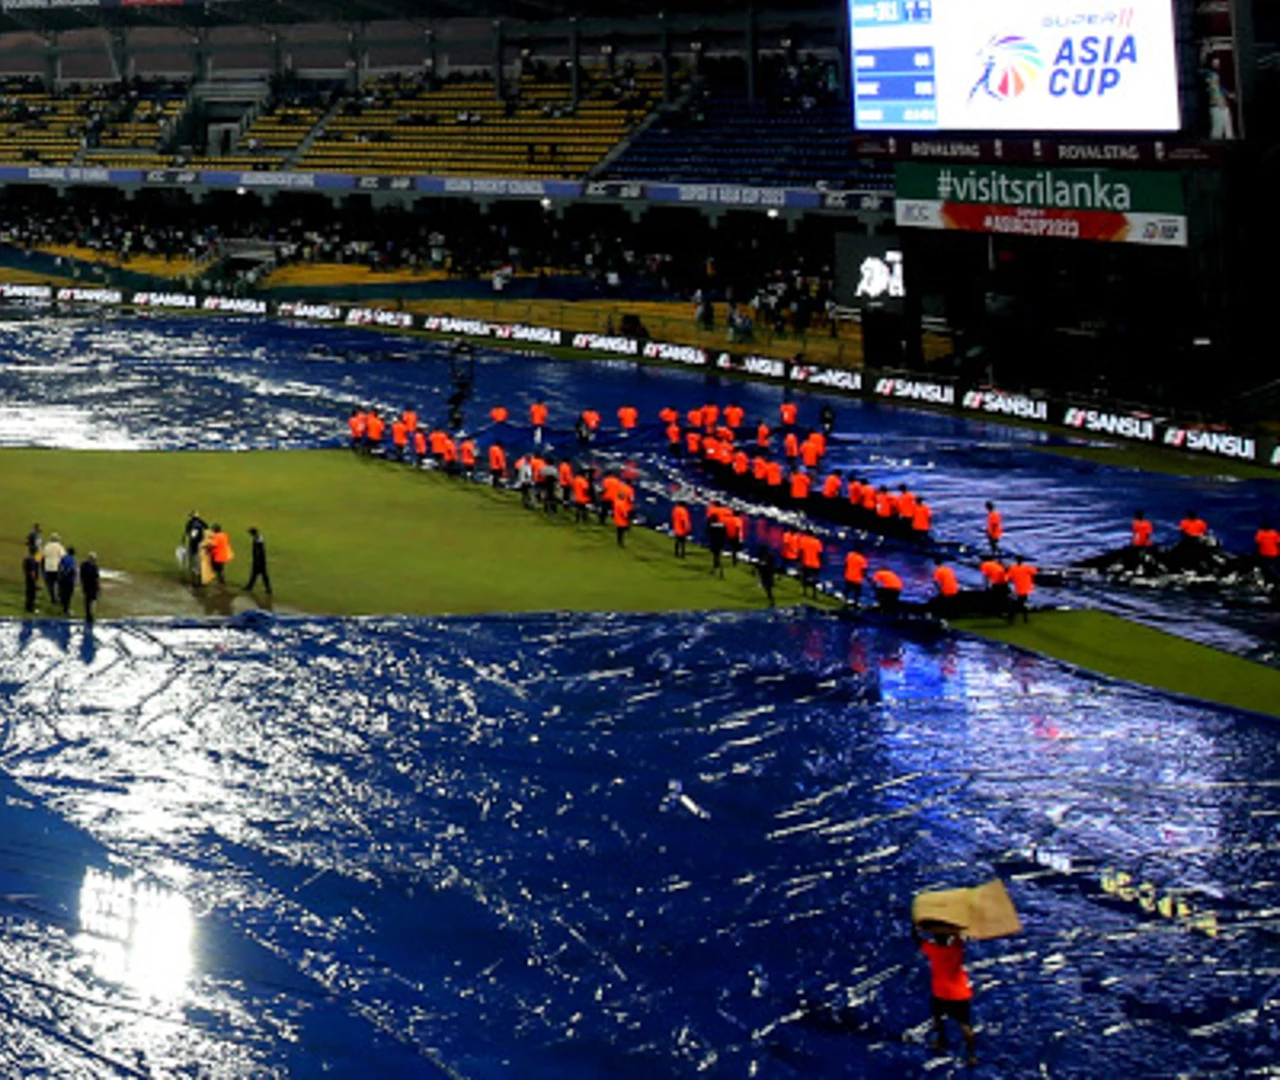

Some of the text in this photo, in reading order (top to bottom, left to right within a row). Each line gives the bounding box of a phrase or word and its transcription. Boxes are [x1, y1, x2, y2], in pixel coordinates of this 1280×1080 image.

[1052, 33, 1138, 67] ASIA
[1047, 67, 1122, 98] CUP
[937, 170, 1131, 211] #visitsrilanka
[149, 292, 196, 307] SANSUI
[219, 298, 266, 313] SANSUI
[512, 325, 560, 344] SANSUI
[589, 334, 637, 354] SANSUI
[659, 343, 707, 364] SANSUI
[894, 379, 955, 404] SANSUI
[985, 392, 1047, 421] SANSUI
[1087, 411, 1153, 441] SANSUI
[1187, 430, 1256, 460] SANSUI
